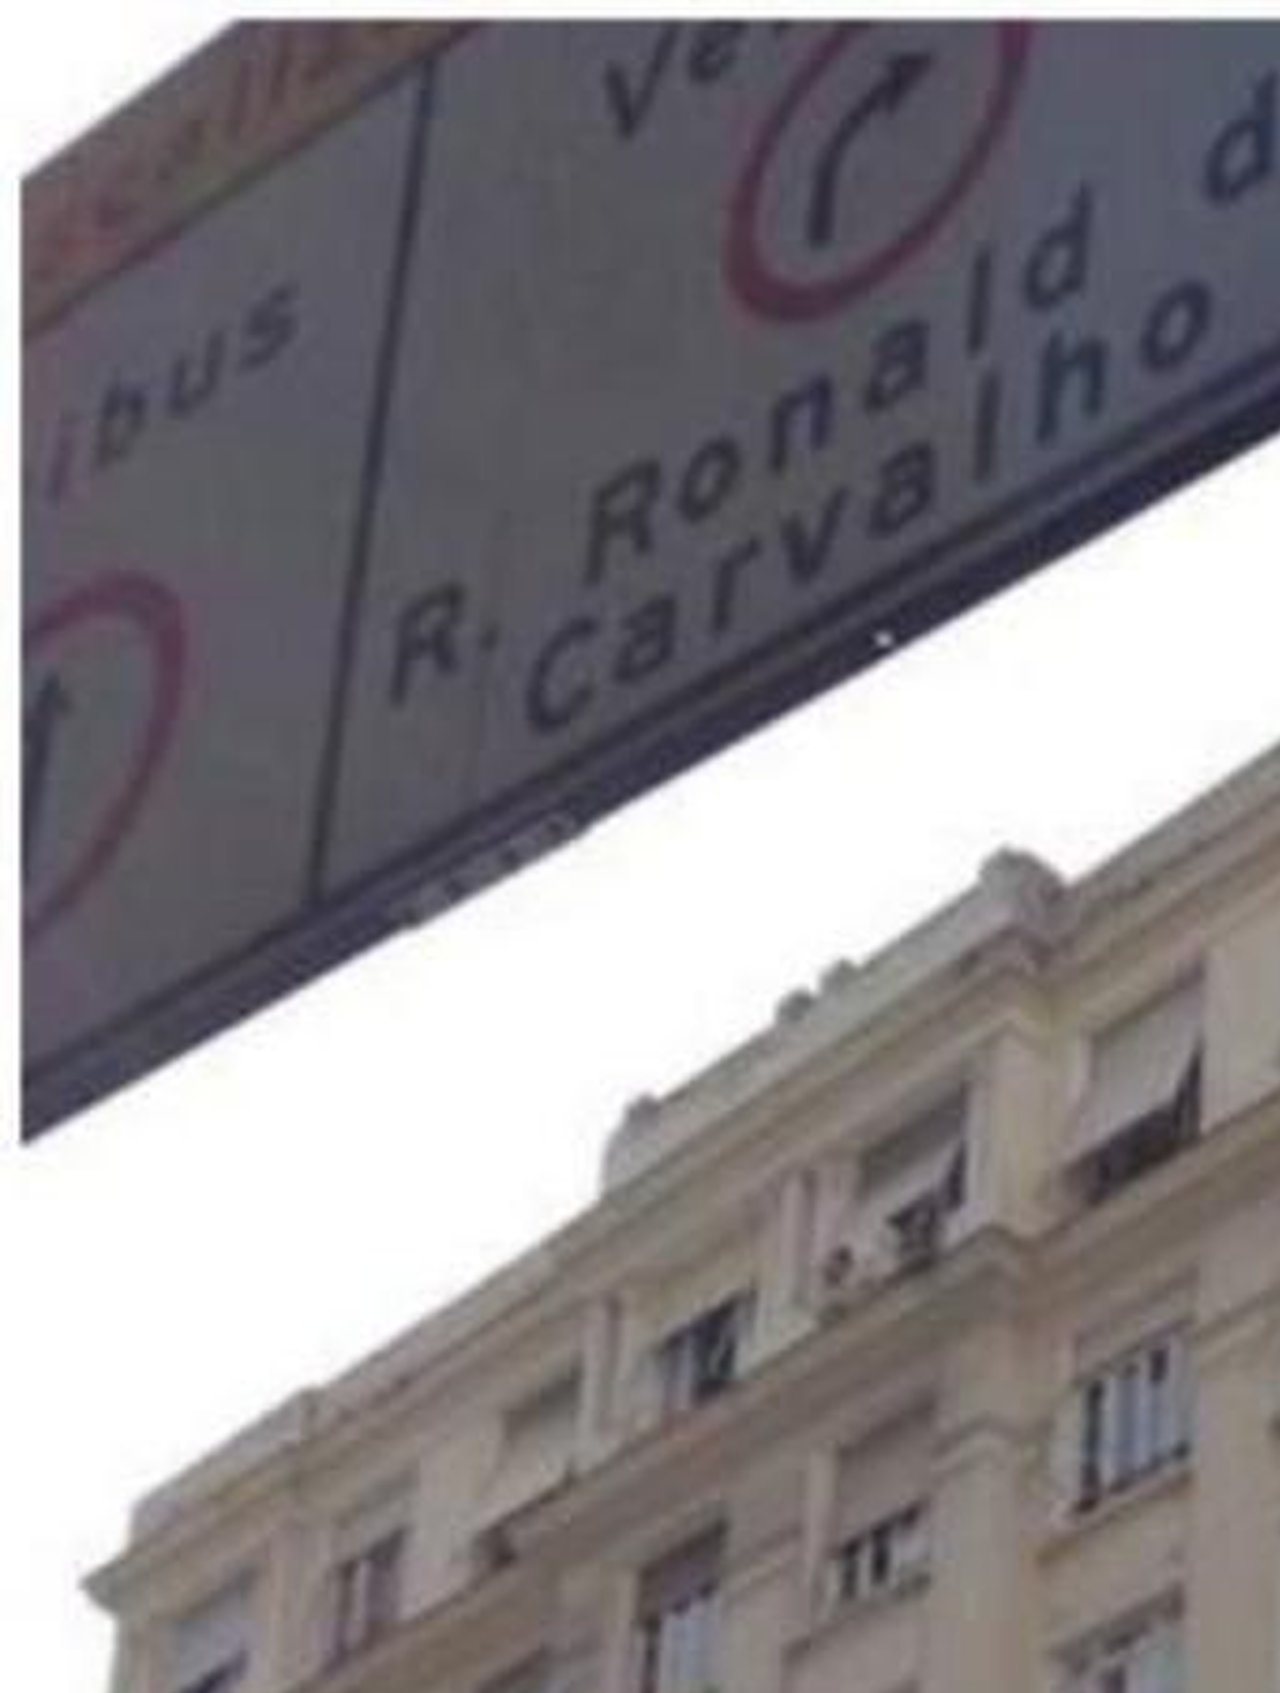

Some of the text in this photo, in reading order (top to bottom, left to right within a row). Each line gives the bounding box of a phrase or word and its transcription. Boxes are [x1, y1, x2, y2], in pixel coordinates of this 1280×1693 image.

[606, 22, 790, 140] Ve
[42, 280, 302, 510] ibus
[388, 580, 502, 708] R.
[584, 181, 1097, 586] Ronald
[523, 281, 1213, 735] Carvalho
